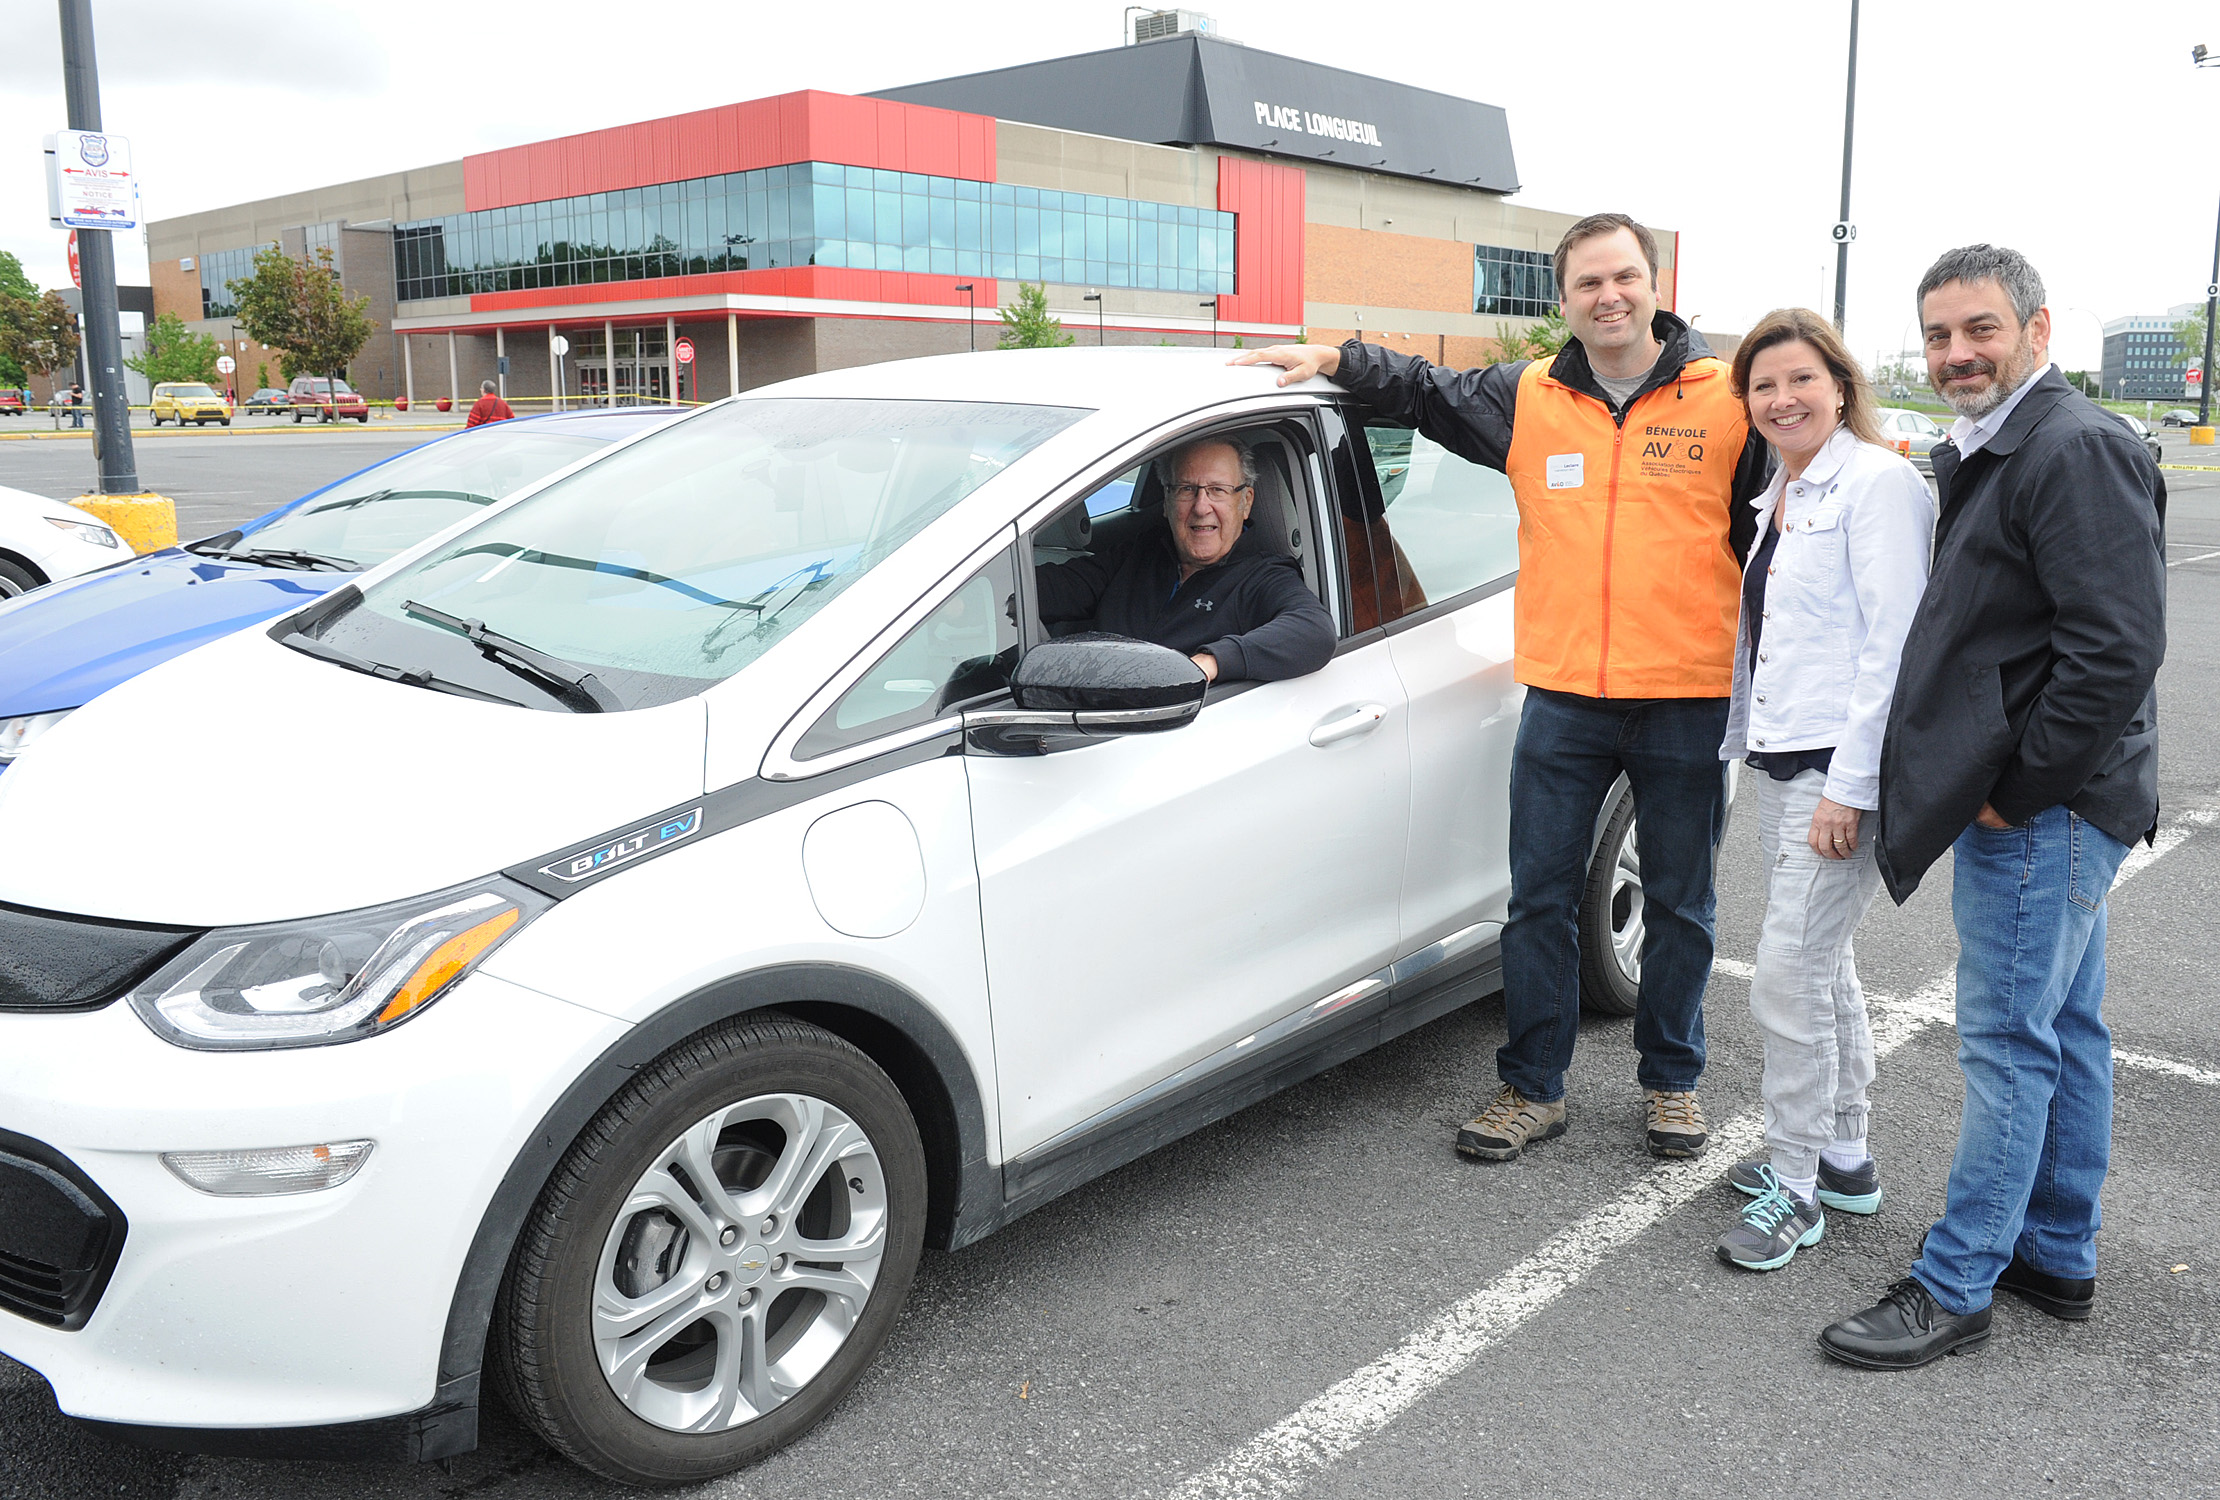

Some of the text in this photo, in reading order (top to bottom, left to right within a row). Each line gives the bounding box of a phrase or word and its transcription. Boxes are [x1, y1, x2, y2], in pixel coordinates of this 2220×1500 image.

[1253, 101, 1382, 147] PLACE LONGUEUIL
[85, 169, 108, 178] AVIS
[1836, 227, 1844, 238] 5
[1645, 425, 1707, 438] BÉNÉVOLE
[571, 815, 694, 875] BOLT EV
